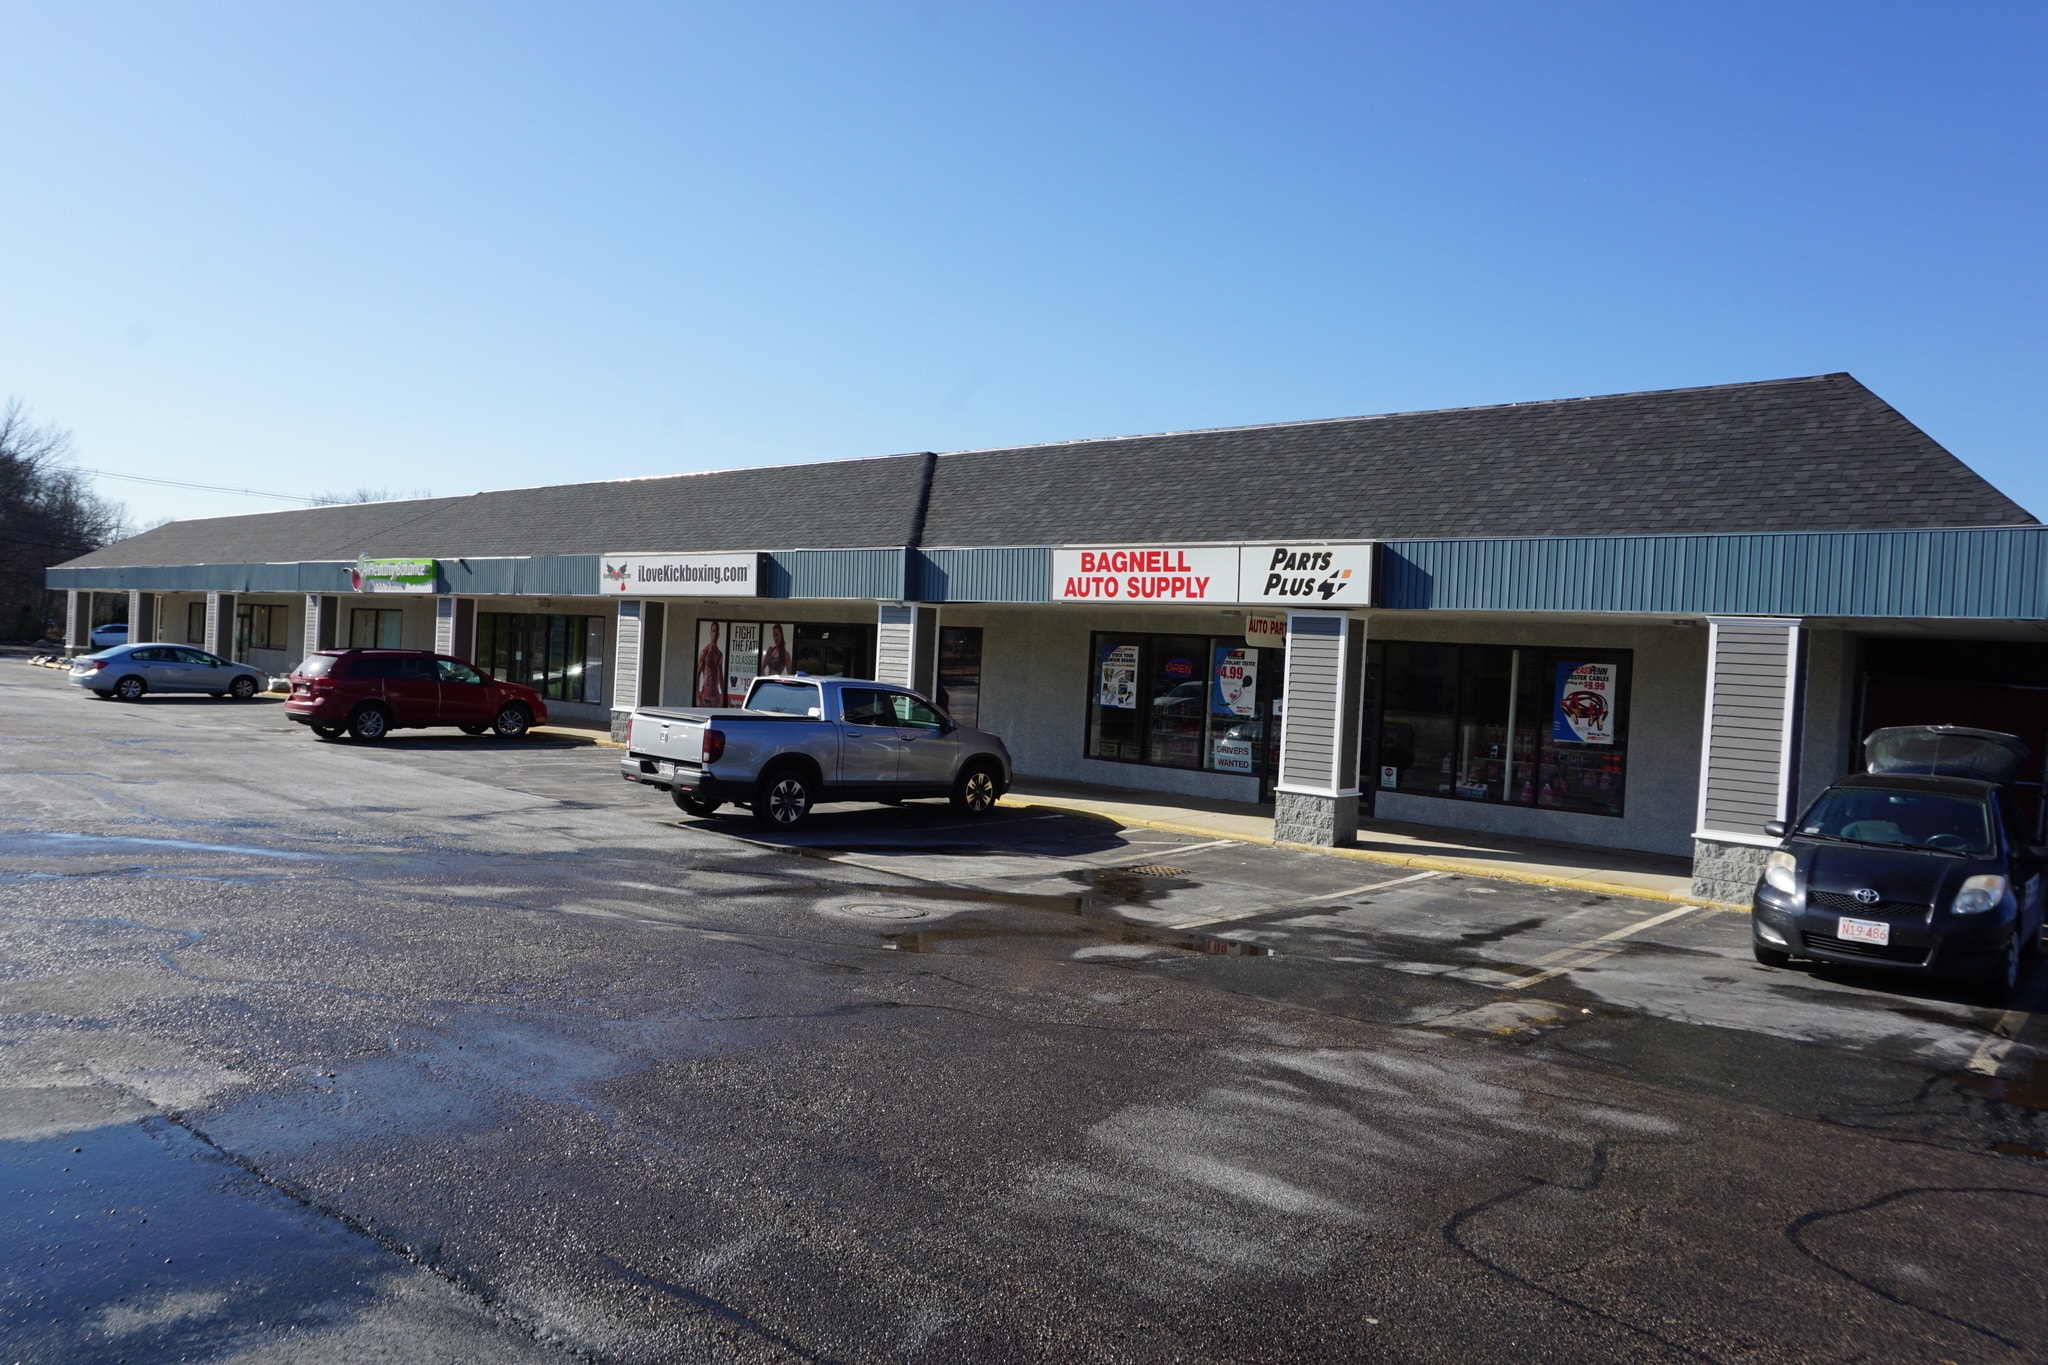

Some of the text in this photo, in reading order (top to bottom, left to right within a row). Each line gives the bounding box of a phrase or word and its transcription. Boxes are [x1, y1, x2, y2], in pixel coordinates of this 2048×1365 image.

[1080, 551, 1192, 573] BAGNELL
[1269, 548, 1333, 571] PARTS
[369, 562, 397, 580] Healthy
[396, 562, 426, 577] Balance
[638, 564, 748, 584] iLoveKickboxing.com
[1063, 576, 1210, 598] AUTO SUPPLY
[1263, 573, 1316, 596] PLUS
[735, 626, 756, 640] FIGHT
[1248, 619, 1268, 634] AUTO
[732, 640, 745, 653] THE
[730, 655, 757, 666] 3 CLASSES
[1167, 662, 1191, 674] OPEN
[1216, 666, 1243, 679] $4.99
[1584, 681, 1605, 690] $9.99
[1588, 675, 1610, 683] CABLES
[1216, 745, 1250, 756] DRIVERS
[1217, 758, 1250, 769] WANTED
